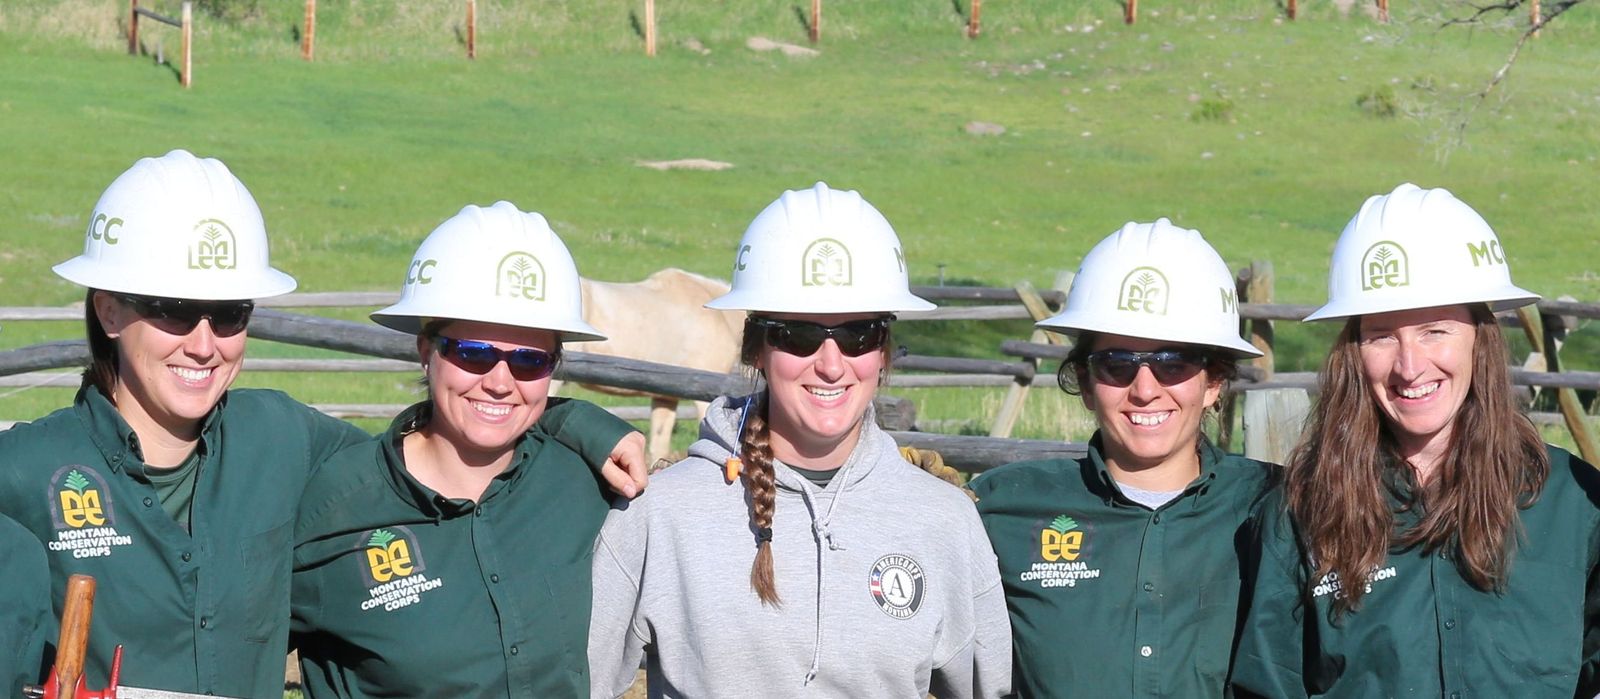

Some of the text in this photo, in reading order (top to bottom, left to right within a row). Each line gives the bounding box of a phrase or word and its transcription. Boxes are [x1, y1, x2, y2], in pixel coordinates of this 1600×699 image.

[1467, 239, 1505, 267] MC
[58, 527, 118, 541] MONTANA
[48, 535, 132, 551] CONSERVATION
[73, 546, 111, 559] CORPS
[876, 556, 922, 580] AMERICORPS
[1031, 561, 1088, 571] MONTANA
[1020, 569, 1100, 582] CONSERVATION
[1040, 578, 1076, 588] CORPS
[361, 577, 443, 611] CONSERVATION
[369, 573, 427, 598] MONTANA
[888, 572, 907, 599] A
[384, 593, 421, 612] CORPS
